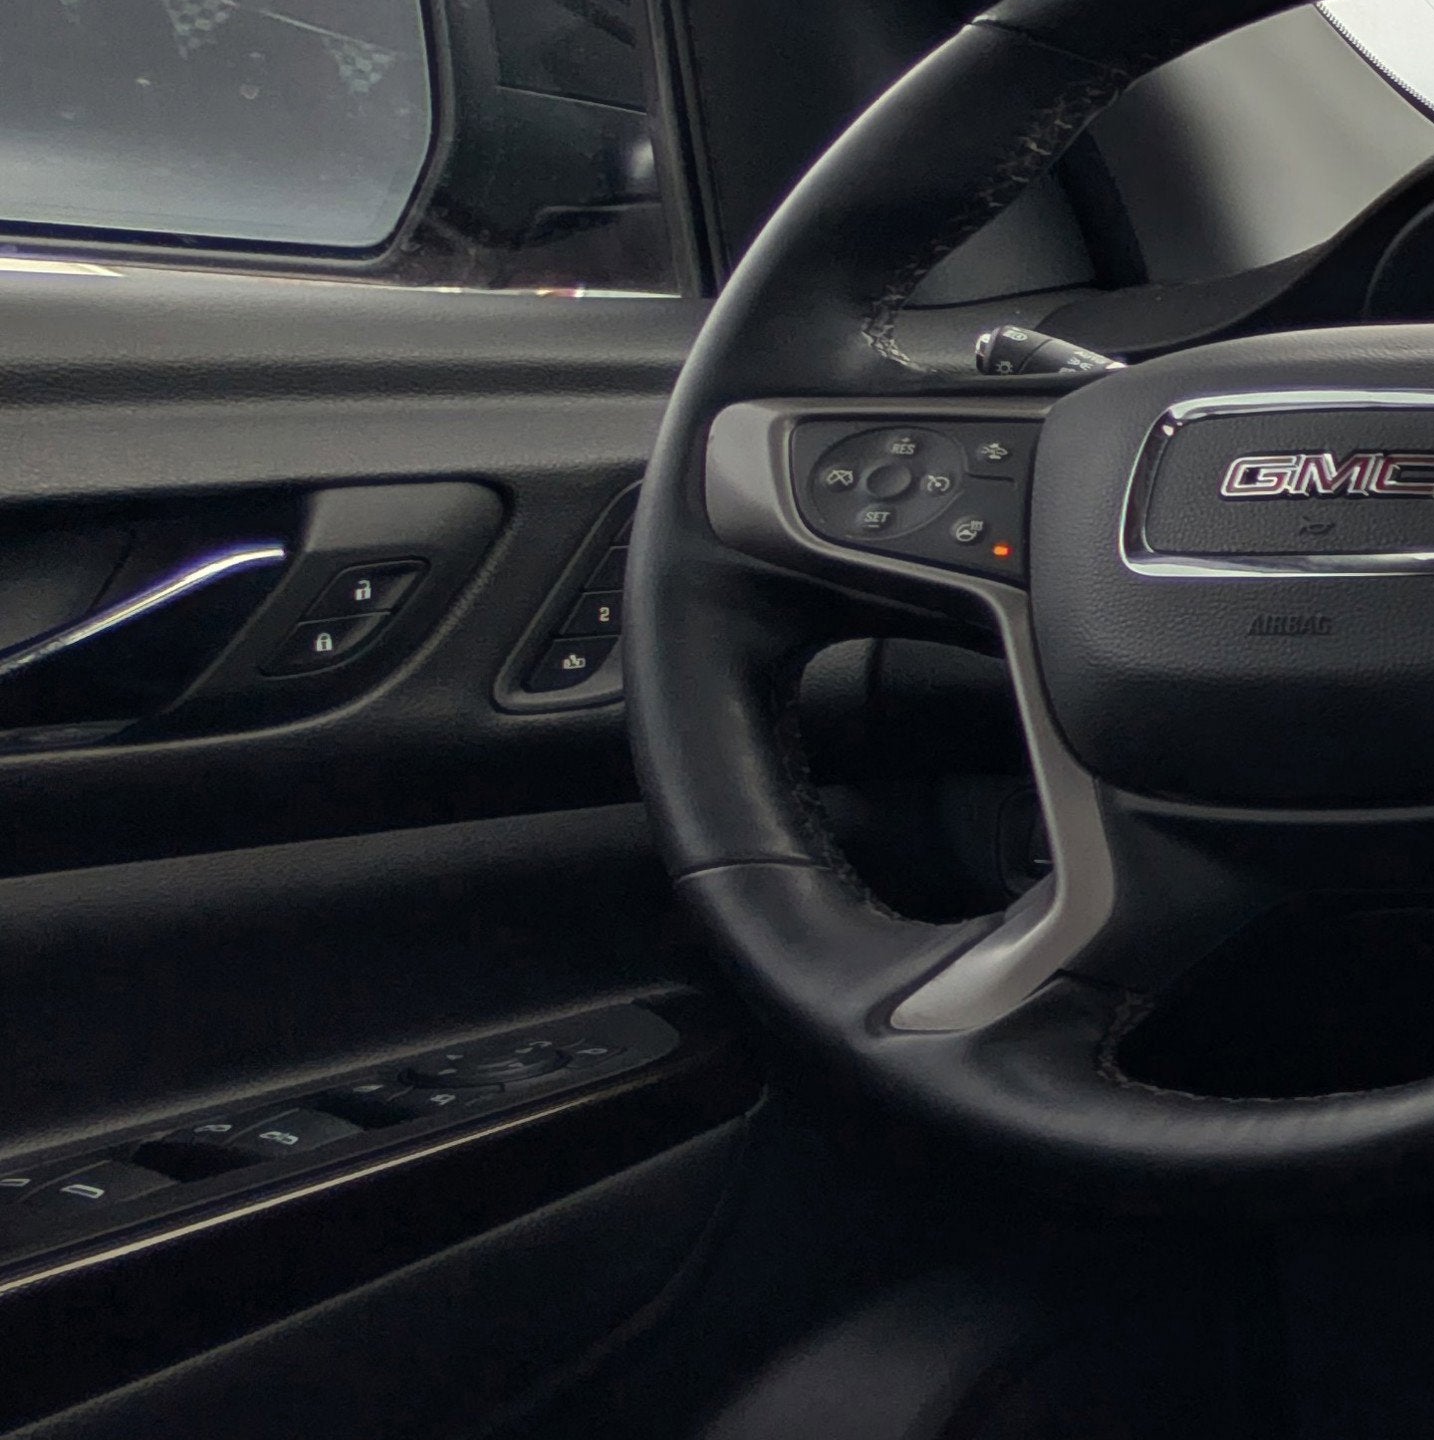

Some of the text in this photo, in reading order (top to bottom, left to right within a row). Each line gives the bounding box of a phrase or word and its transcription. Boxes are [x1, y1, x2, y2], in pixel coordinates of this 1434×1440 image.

[892, 444, 915, 454] RES
[864, 511, 890, 523] SET
[1248, 615, 1333, 636] AIRBAG
